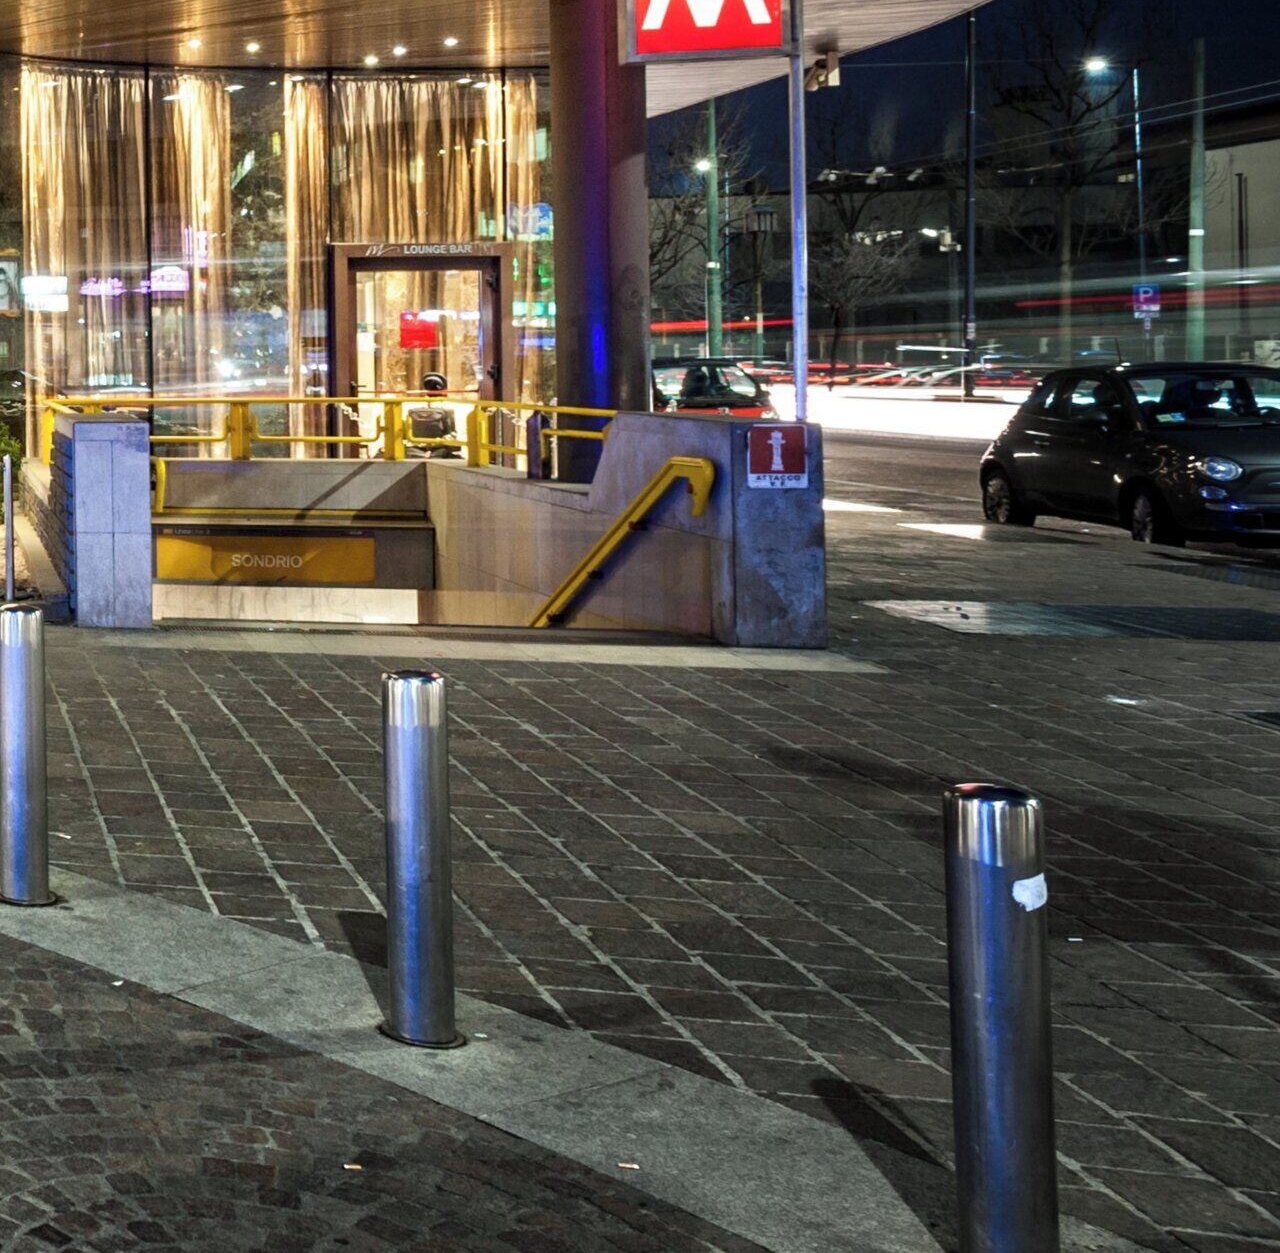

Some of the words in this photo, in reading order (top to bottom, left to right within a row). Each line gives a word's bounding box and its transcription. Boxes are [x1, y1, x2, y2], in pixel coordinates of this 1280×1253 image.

[403, 244, 447, 254] LOUNGE
[449, 244, 472, 254] BAR
[1139, 287, 1154, 302] P
[230, 553, 303, 569] SONDRIO
